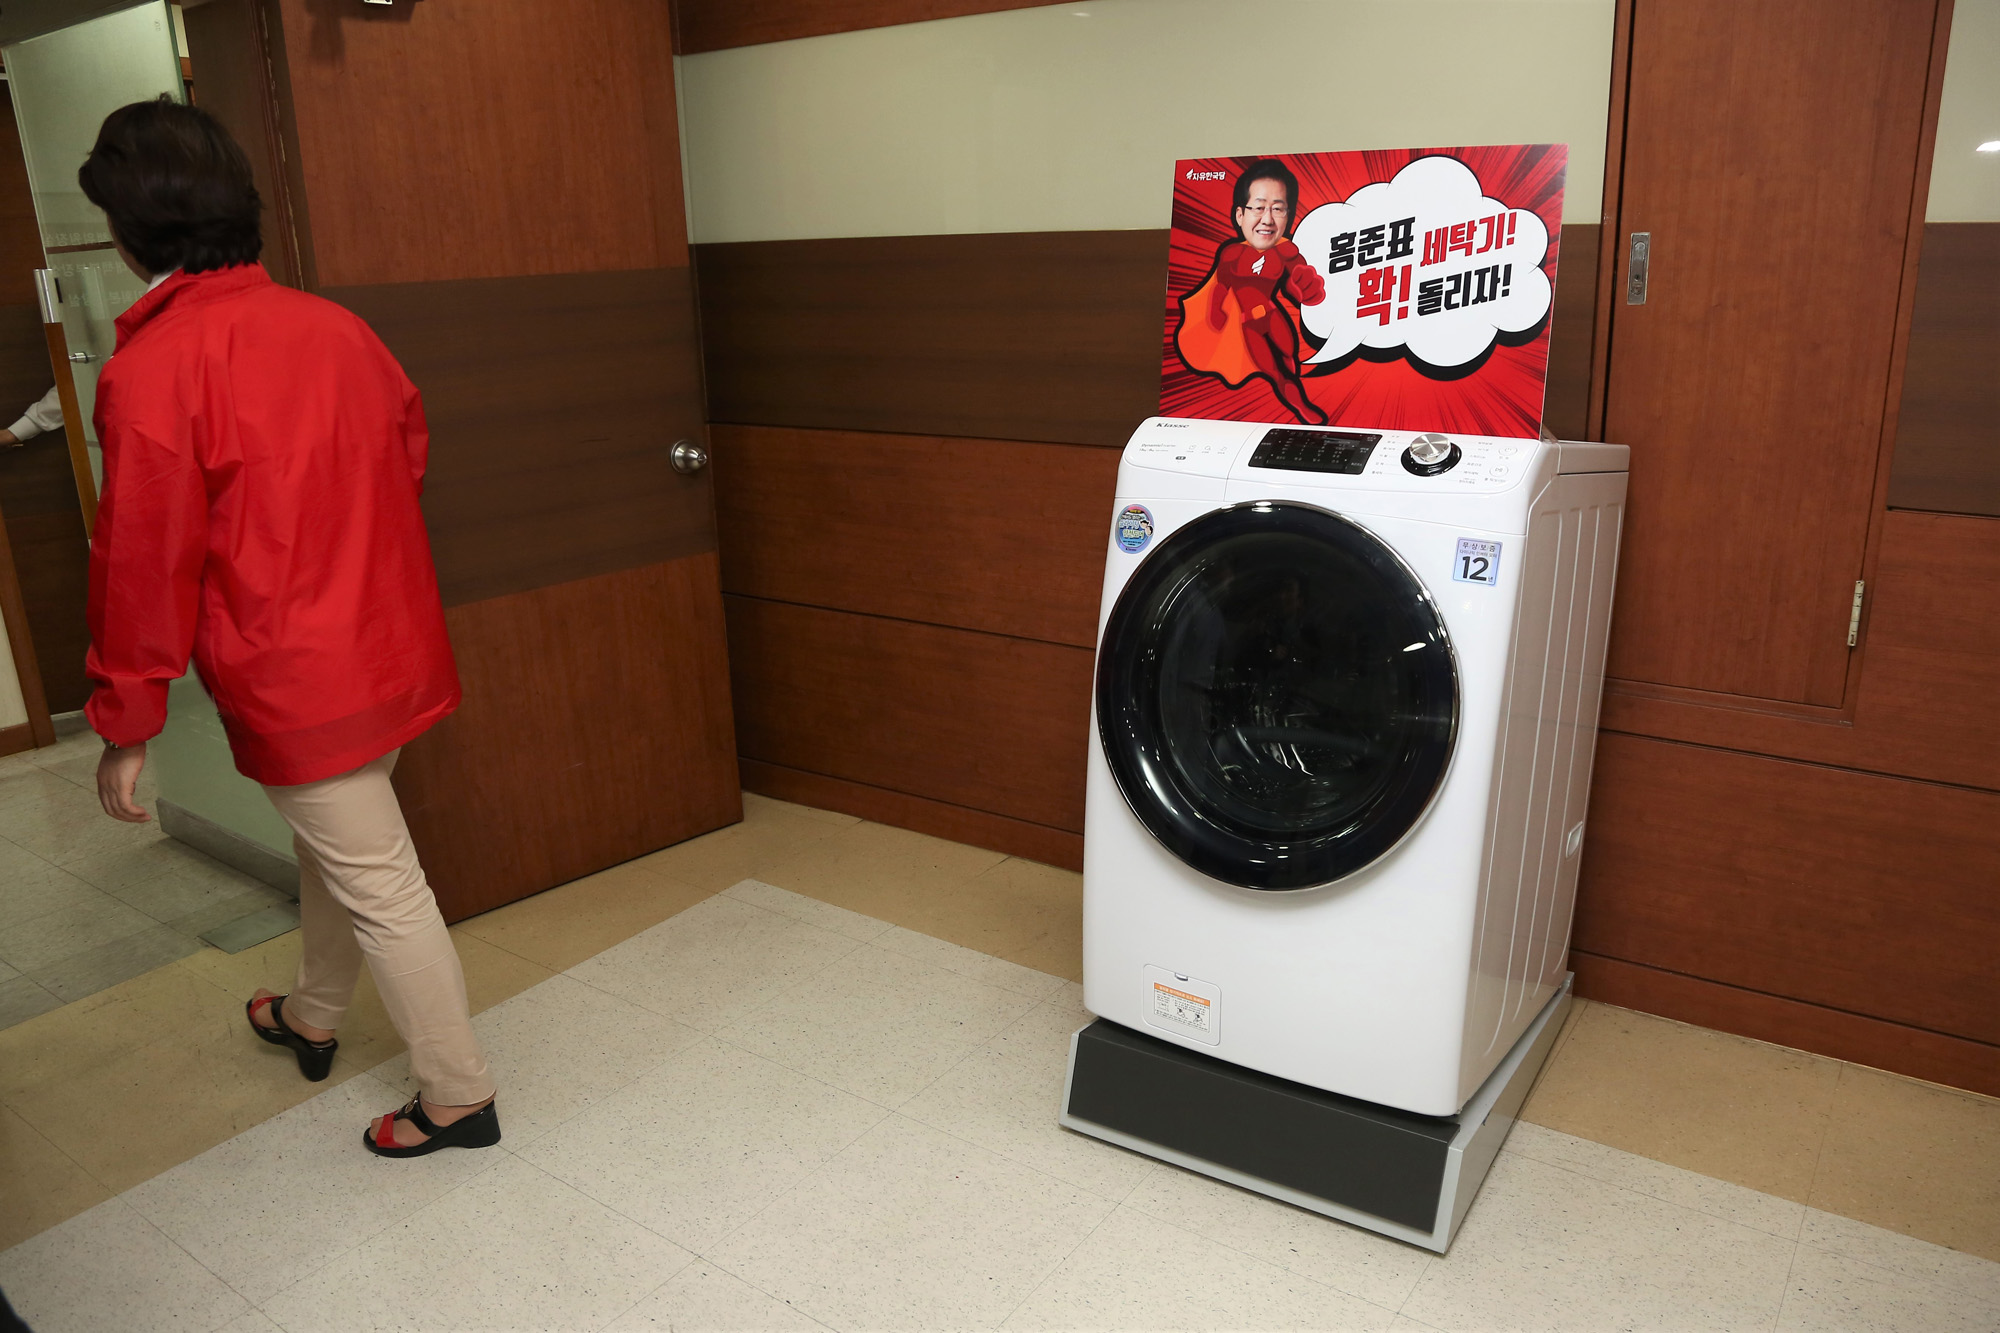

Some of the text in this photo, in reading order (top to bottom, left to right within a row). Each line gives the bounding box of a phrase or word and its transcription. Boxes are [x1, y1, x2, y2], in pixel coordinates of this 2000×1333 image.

[1192, 171, 1226, 181] 자유한국당
[1328, 211, 1517, 274] 홍준표 세탁기!
[1356, 263, 1512, 326] 확! 돌리자!
[1462, 555, 1489, 582] 12
